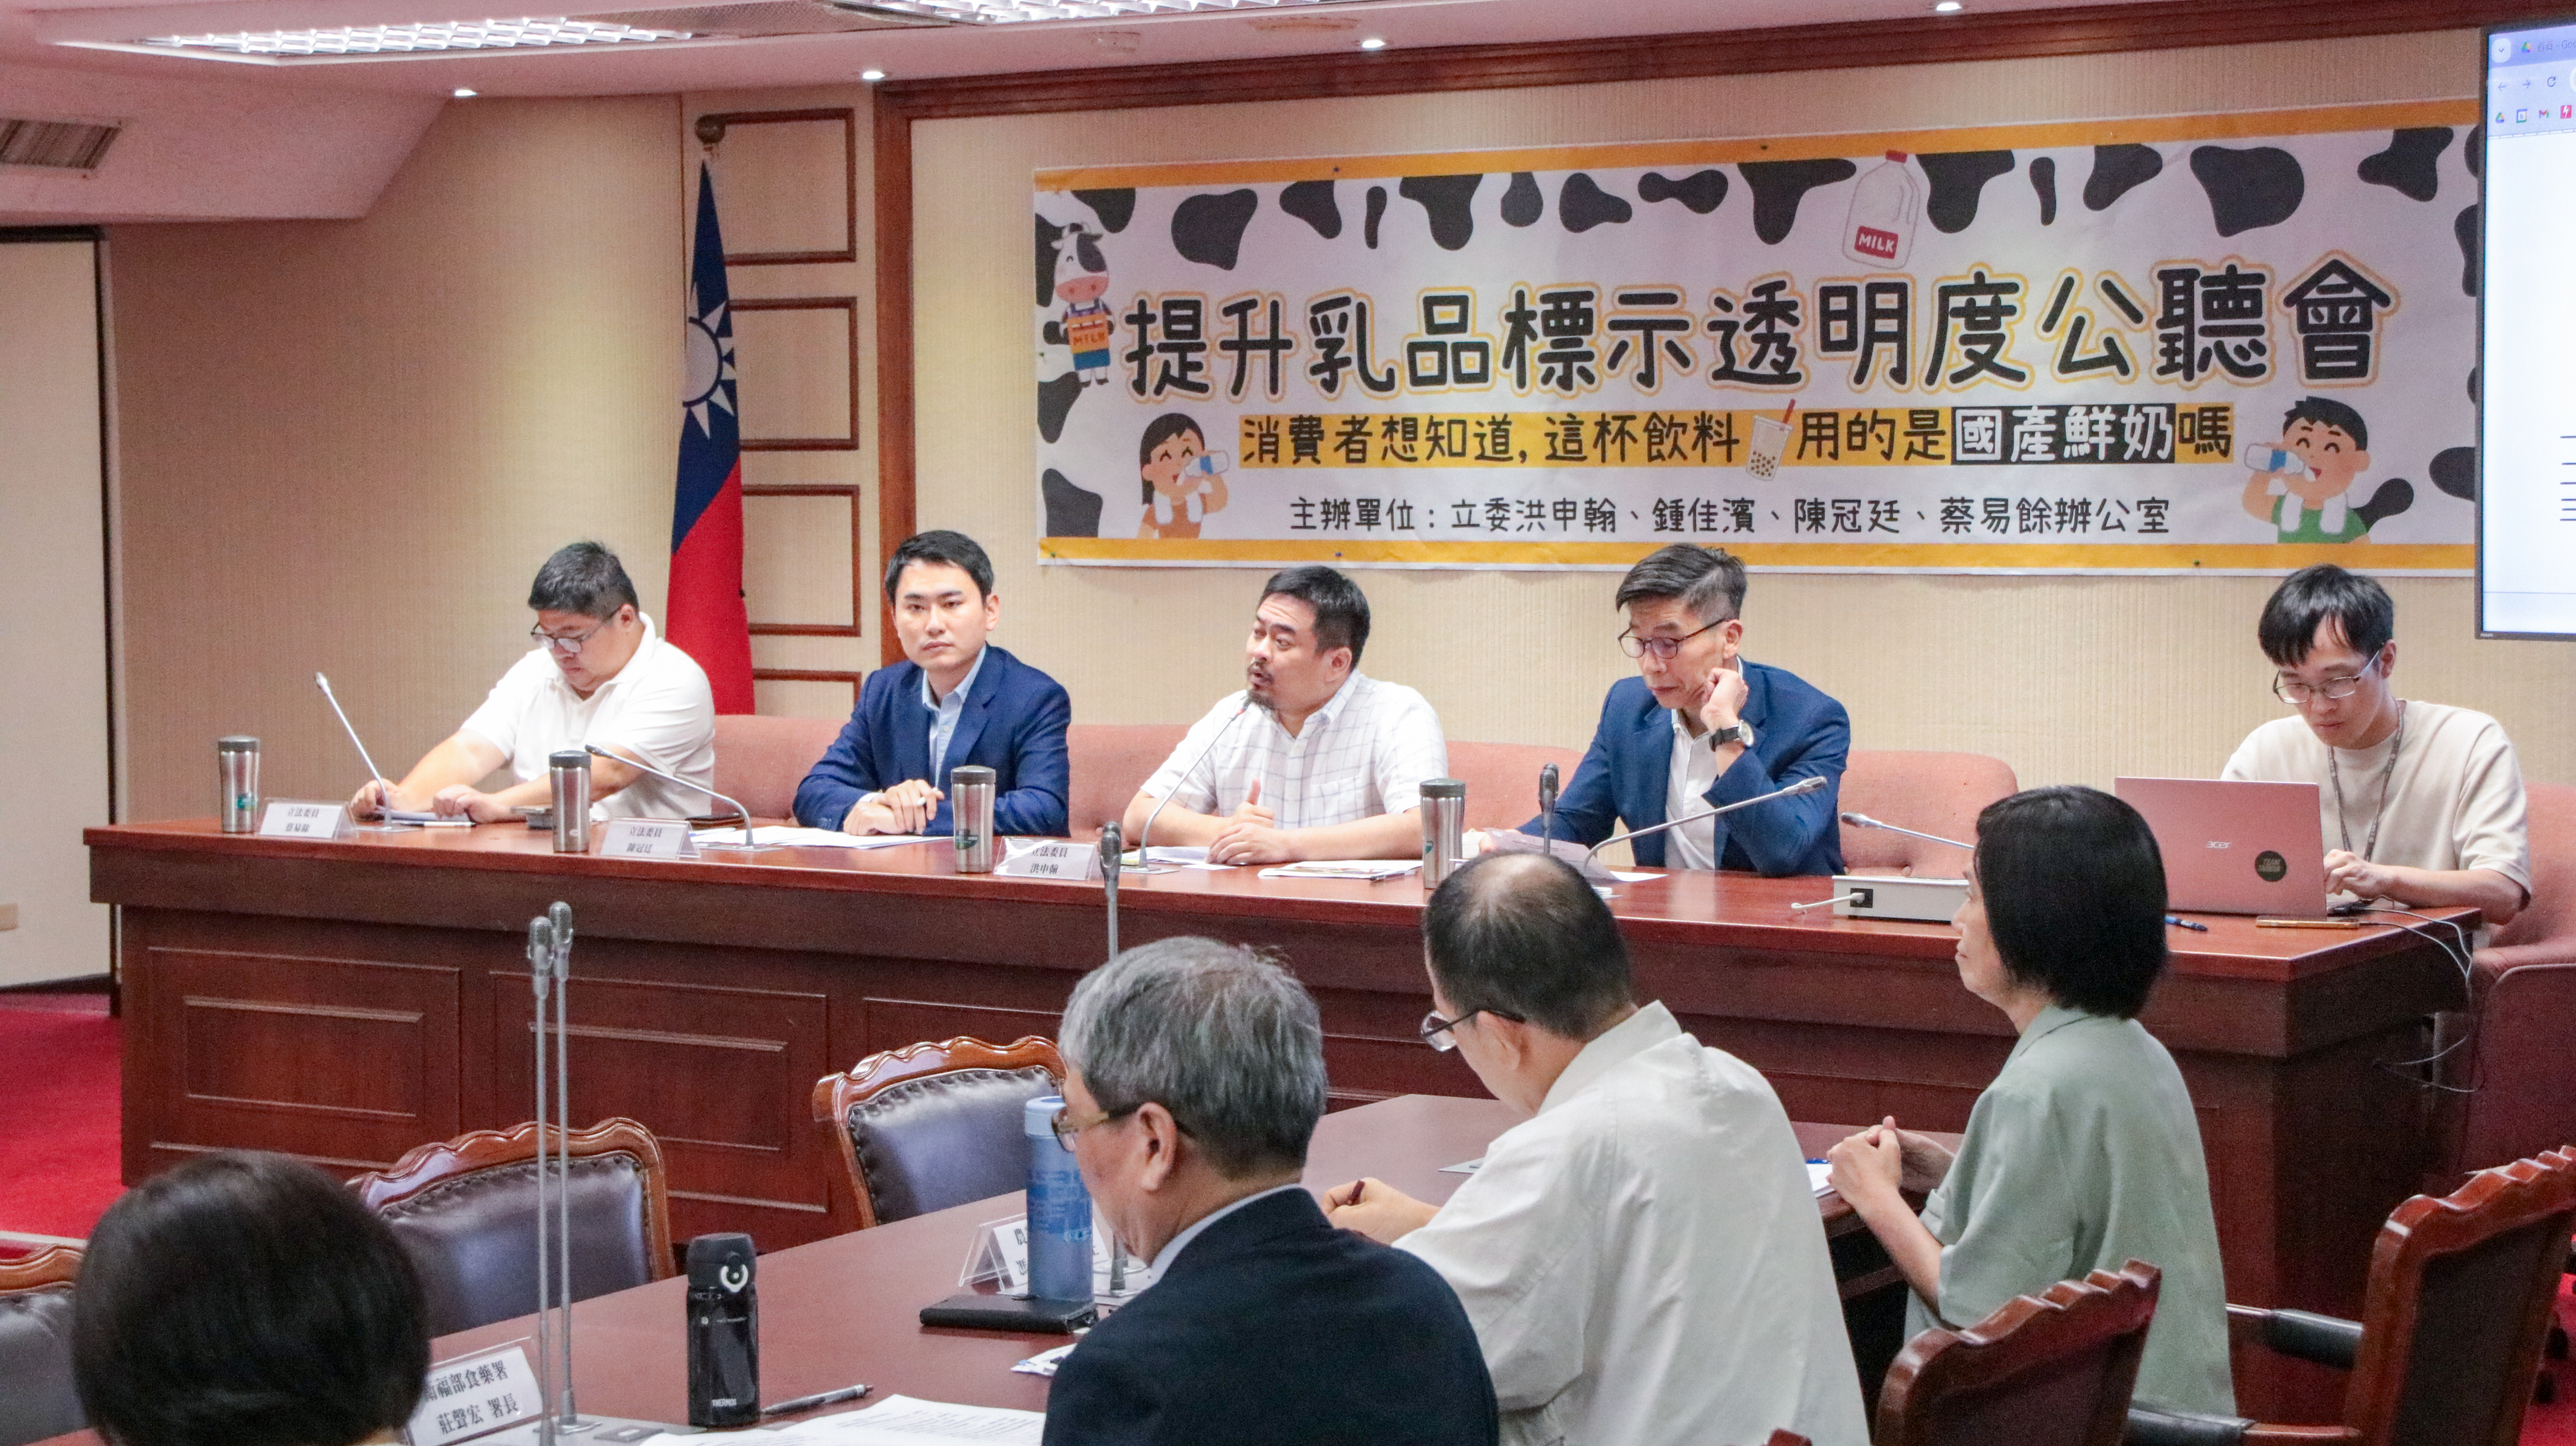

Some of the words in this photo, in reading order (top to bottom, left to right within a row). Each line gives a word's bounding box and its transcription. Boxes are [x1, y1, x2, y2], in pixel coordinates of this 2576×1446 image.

[1859, 233, 1895, 253] MILK
[1124, 258, 2392, 397] 提升乳品標示透明度公聽會
[1795, 404, 2233, 464] 用的是國產鮮奶嗎
[629, 826, 662, 838] 立法委員
[2207, 841, 2231, 849] acer
[1031, 846, 1068, 858] 立法委員
[1030, 863, 1059, 874] 洪申翰
[487, 1393, 519, 1418] 署長
[712, 1398, 737, 1407] THERMOS
